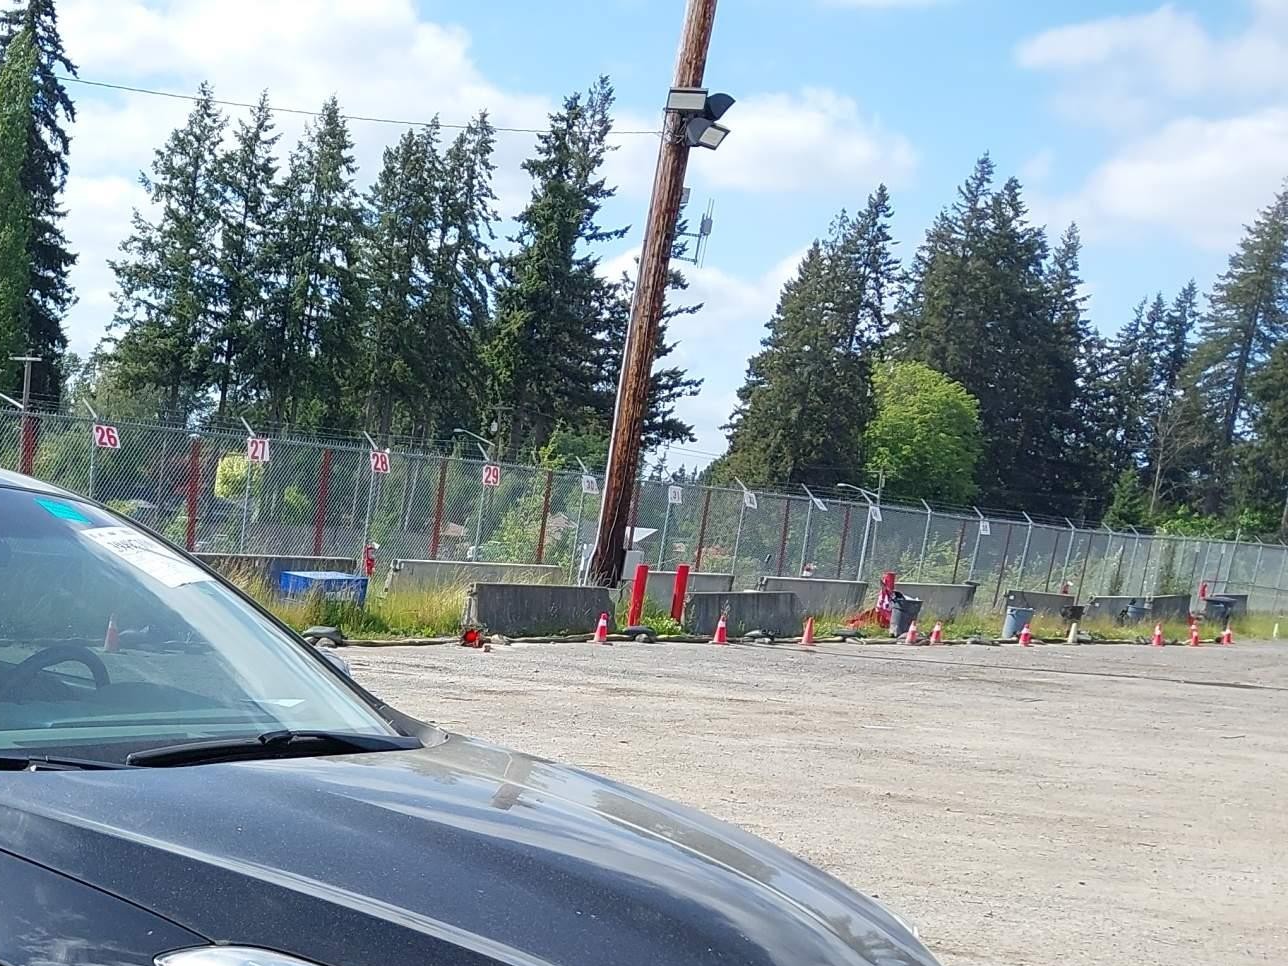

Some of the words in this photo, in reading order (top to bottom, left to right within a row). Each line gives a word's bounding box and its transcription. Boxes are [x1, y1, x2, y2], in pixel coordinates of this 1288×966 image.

[95, 426, 118, 448] 26
[250, 440, 266, 460] 27
[372, 453, 389, 472] 28
[484, 466, 499, 485] 29
